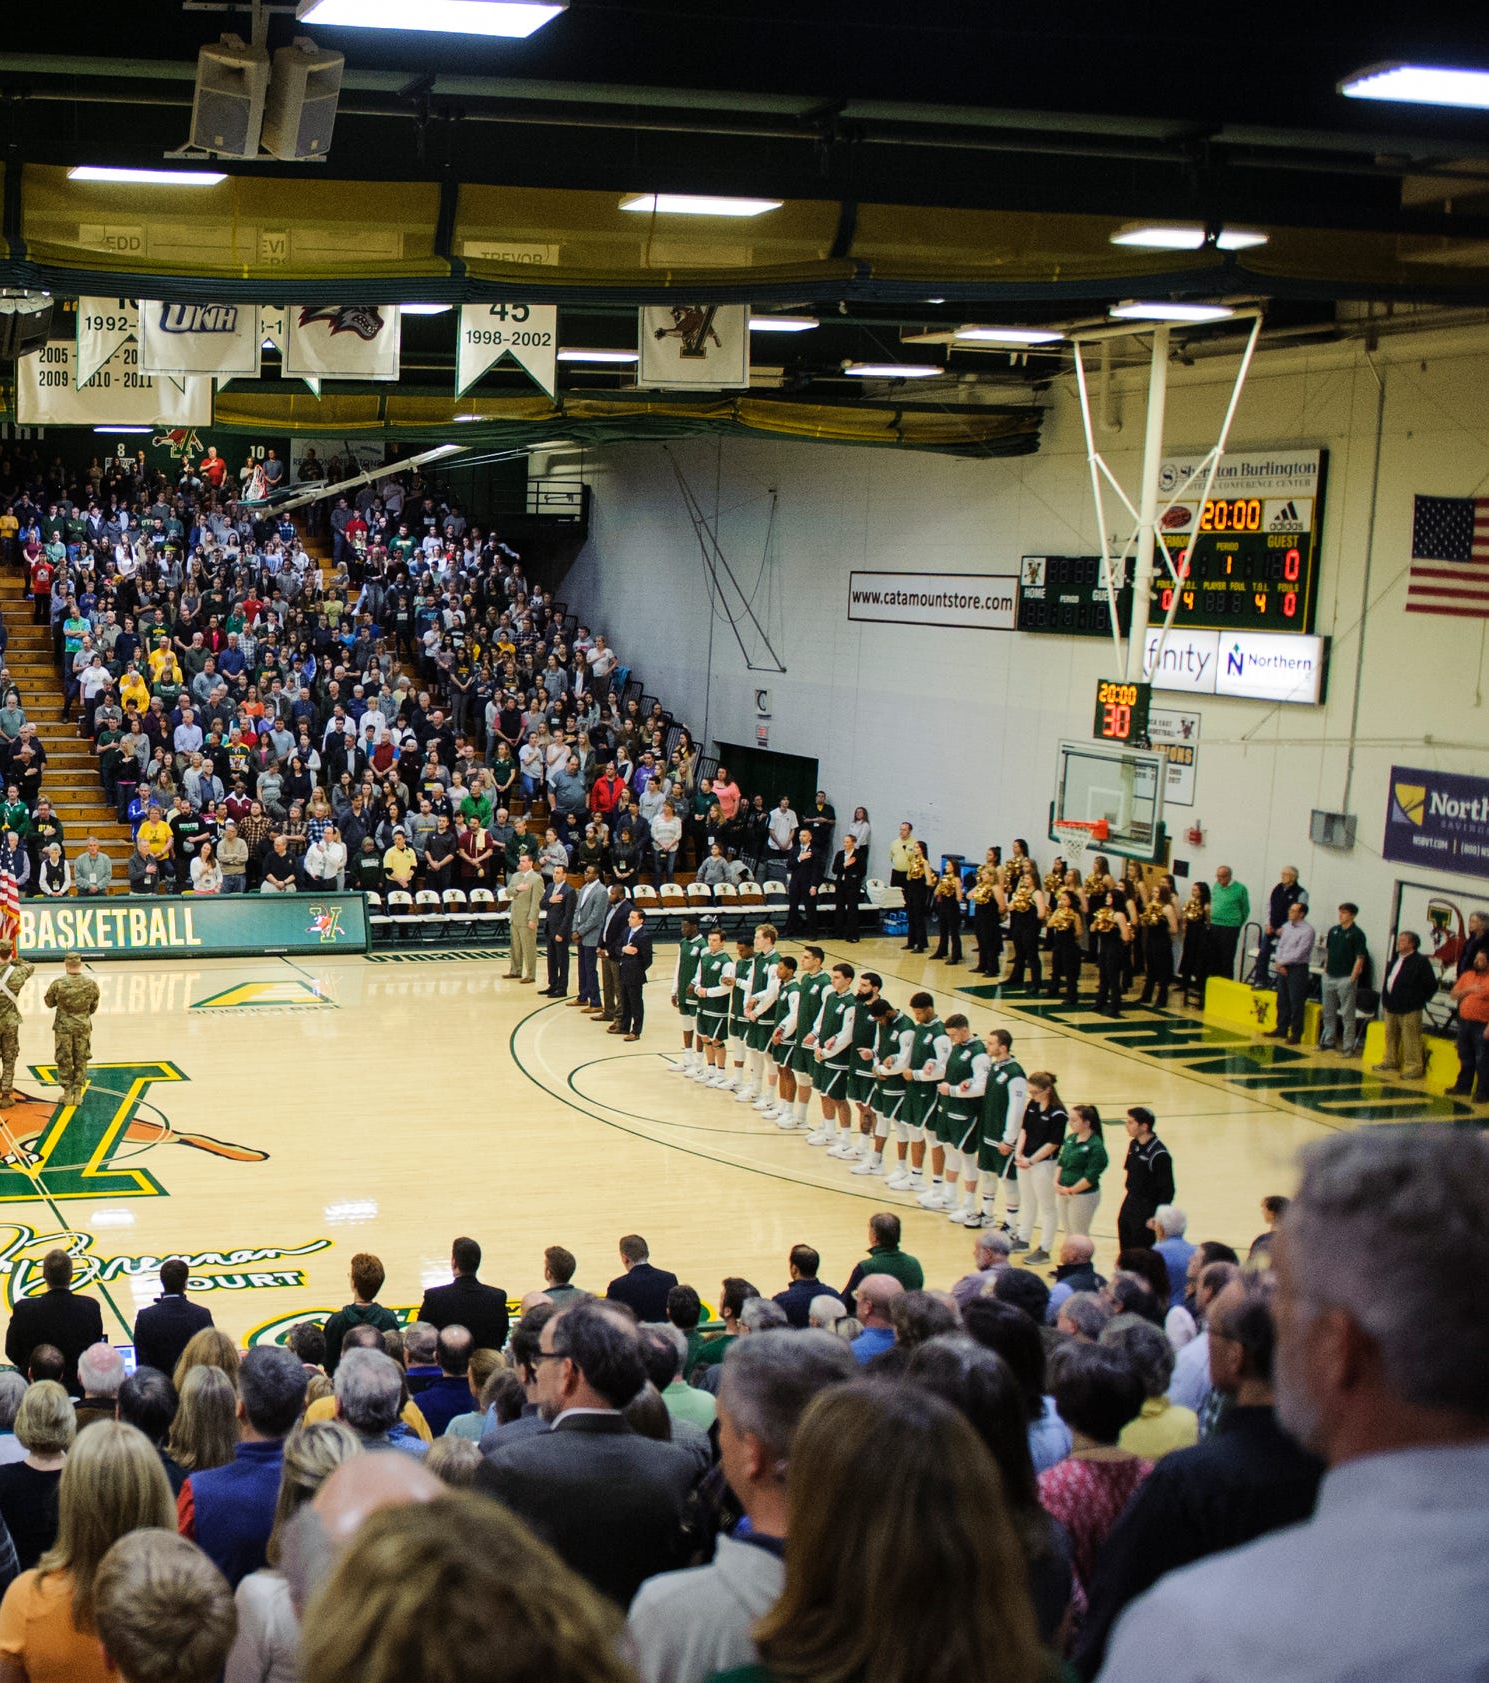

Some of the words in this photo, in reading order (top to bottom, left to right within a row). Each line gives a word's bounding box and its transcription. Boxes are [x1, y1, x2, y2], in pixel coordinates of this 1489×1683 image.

[465, 330, 552, 347] 1998-2002
[39, 347, 68, 363] 2005
[39, 371, 68, 387] 2009
[124, 372, 153, 388] 2011
[250, 445, 266, 459] 10
[1241, 461, 1317, 478] Burlington
[1200, 499, 1261, 531] 20:00
[1269, 521, 1304, 532] adidas
[1267, 535, 1300, 548] GUEST
[1226, 554, 1233, 575] 1
[1284, 548, 1300, 582] 0
[852, 588, 1013, 612] www.catamountstore.com
[1024, 587, 1046, 599] HOME
[1254, 593, 1267, 614] 4
[1283, 591, 1297, 618] 0
[1248, 653, 1312, 672] Northern
[1098, 683, 1138, 706] 20:00
[1102, 703, 1131, 739] 30
[19, 907, 202, 950] BASKETBALL
